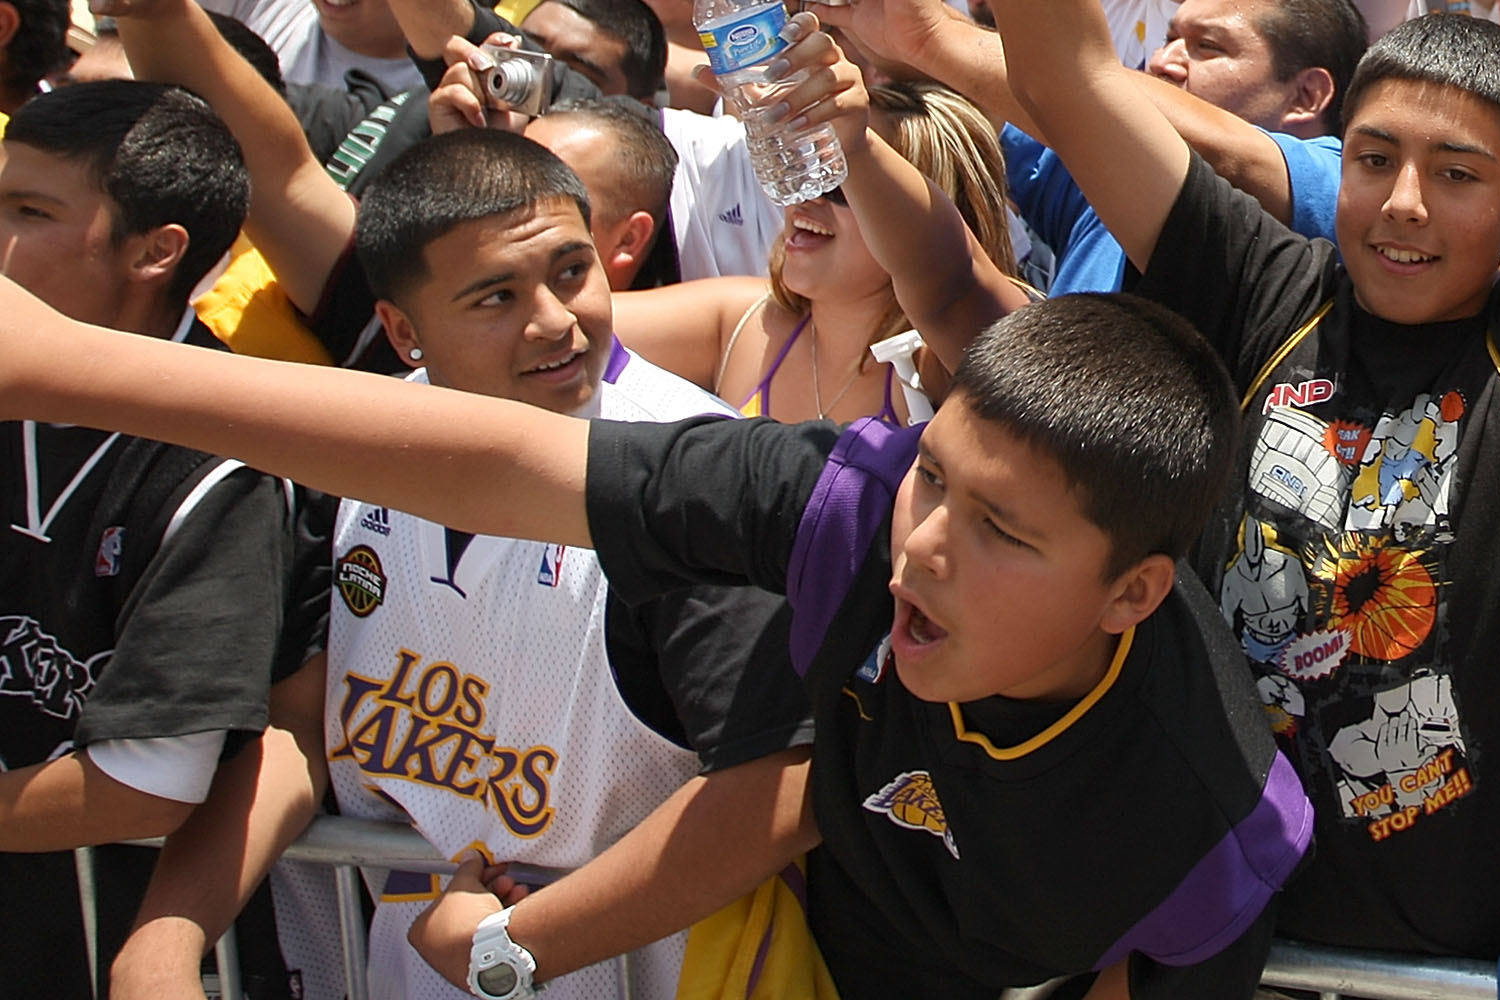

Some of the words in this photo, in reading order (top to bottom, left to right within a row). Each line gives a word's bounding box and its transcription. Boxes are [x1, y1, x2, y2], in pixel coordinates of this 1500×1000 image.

[360, 518, 392, 537] adidas
[342, 562, 382, 587] NOCHE
[1294, 634, 1345, 673] BOOM!
[374, 647, 491, 730] LOS
[328, 669, 560, 840] LAKERS
[1350, 783, 1395, 817] YOU
[1368, 805, 1420, 842] STOP
[1423, 767, 1472, 816] ME!!
